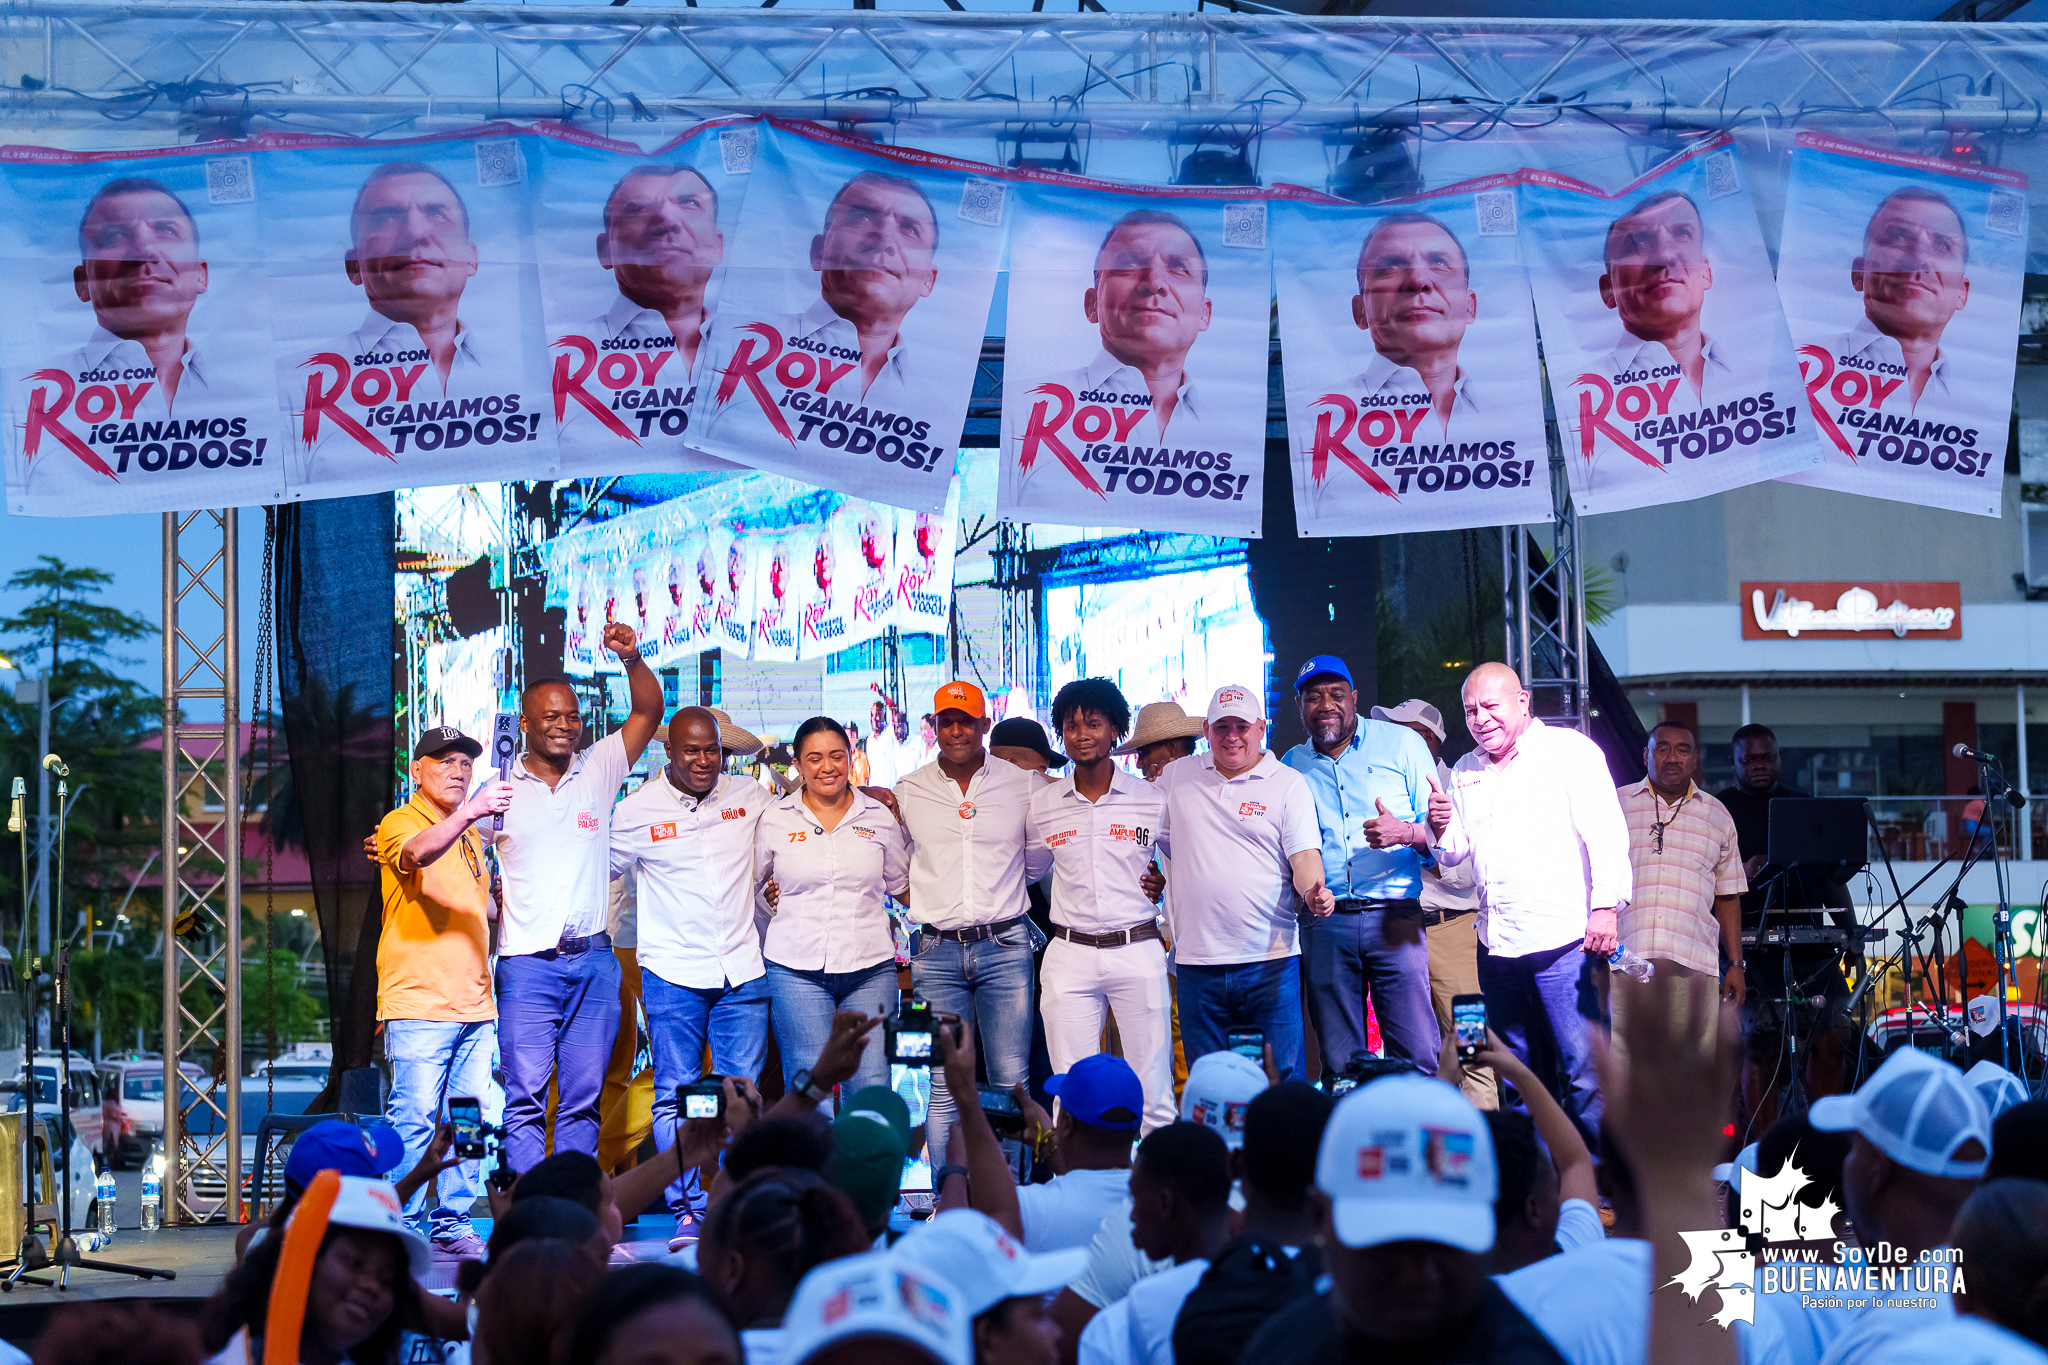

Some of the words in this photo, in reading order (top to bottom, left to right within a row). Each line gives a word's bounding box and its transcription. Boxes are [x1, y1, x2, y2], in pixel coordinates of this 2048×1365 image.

[802, 125, 830, 139] MARZO
[831, 134, 844, 142] EN
[856, 140, 896, 156] CONSULTA
[898, 151, 927, 162] MARCA
[949, 160, 1000, 173] PRESIDENTE!
[1824, 141, 1835, 149] DE
[1836, 144, 1863, 154] MARZO
[1928, 161, 1957, 171] MARCA
[1058, 175, 1087, 184] MARZO
[1207, 188, 1257, 196] PRESIDENTE!
[1454, 177, 1504, 192] PRESIDENTE!
[353, 350, 394, 366] SÓLO
[396, 348, 431, 364] CON
[601, 337, 641, 352] SÓLO
[644, 336, 676, 350] CON
[787, 335, 826, 359] SÓLO
[829, 342, 863, 364] CON
[79, 368, 120, 384] SÓLO
[122, 367, 157, 380] CON
[1613, 368, 1649, 386] SÓLO
[1651, 363, 1682, 380] CON
[1838, 355, 1873, 371] SÓLO
[1875, 361, 1908, 378] CON
[547, 335, 674, 448] ROY
[712, 322, 857, 451] ROY
[1078, 388, 1119, 405] SÓLO
[1120, 393, 1154, 407] CON
[1360, 392, 1399, 408] SÓLO
[1400, 392, 1433, 405] CON
[290, 352, 430, 464] ROY
[365, 394, 521, 428] ¡GANAMOS
[778, 388, 931, 442] ¡GANAMOS
[1634, 391, 1775, 442] ¡GANAMOS
[1796, 344, 1905, 466] ROY
[14, 368, 154, 484] ROY
[88, 417, 248, 445] ¡GANAMOS
[389, 412, 541, 455] TODOS!
[1567, 372, 1682, 474] ROY
[1656, 406, 1797, 464] TODOS!
[1837, 405, 1978, 448] ¡GANAMOS
[112, 437, 268, 474] TODOS!
[796, 414, 944, 474] TODOS!
[1012, 382, 1148, 502] ROY
[1081, 442, 1233, 473] ¡GANAMOS
[1300, 393, 1431, 505] ROY
[1371, 440, 1516, 468] ¡GANAMOS
[1856, 432, 1992, 477] TODOS!
[1103, 466, 1250, 501] TODOS!
[1396, 459, 1535, 495] TODOS!
[787, 830, 807, 844] 73
[1058, 829, 1078, 840] CASTILLO
[1109, 828, 1136, 838] AMPLIO
[1136, 826, 1149, 847] 96
